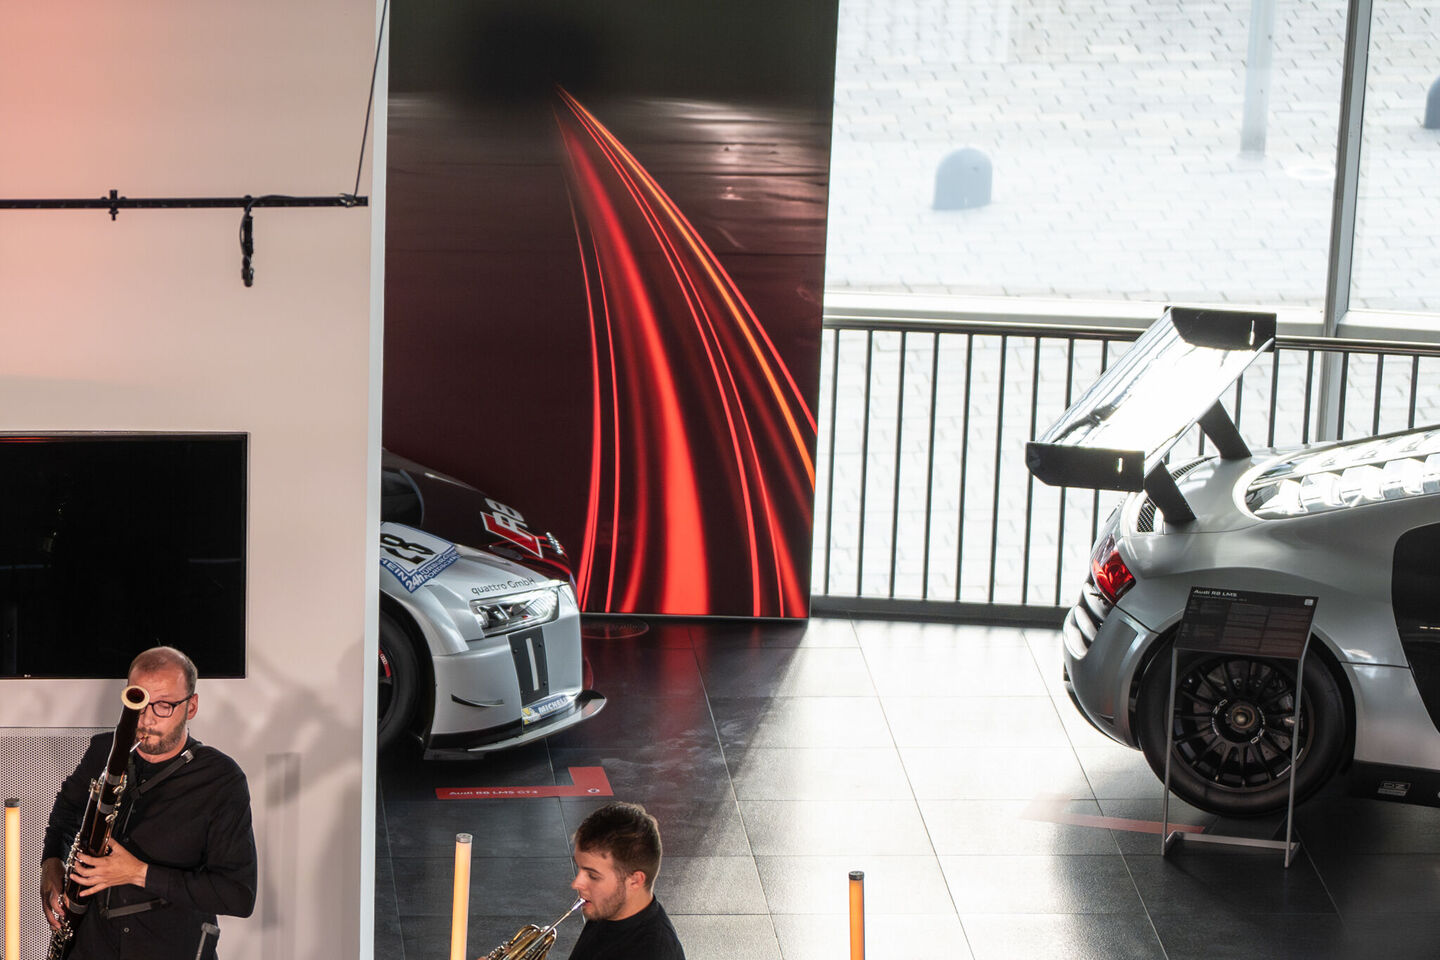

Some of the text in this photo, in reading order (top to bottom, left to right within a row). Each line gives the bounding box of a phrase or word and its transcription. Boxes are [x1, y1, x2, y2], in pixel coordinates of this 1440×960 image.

[485, 498, 532, 541] R8
[405, 573, 425, 592] 24h
[471, 577, 536, 595] quattro GmbH
